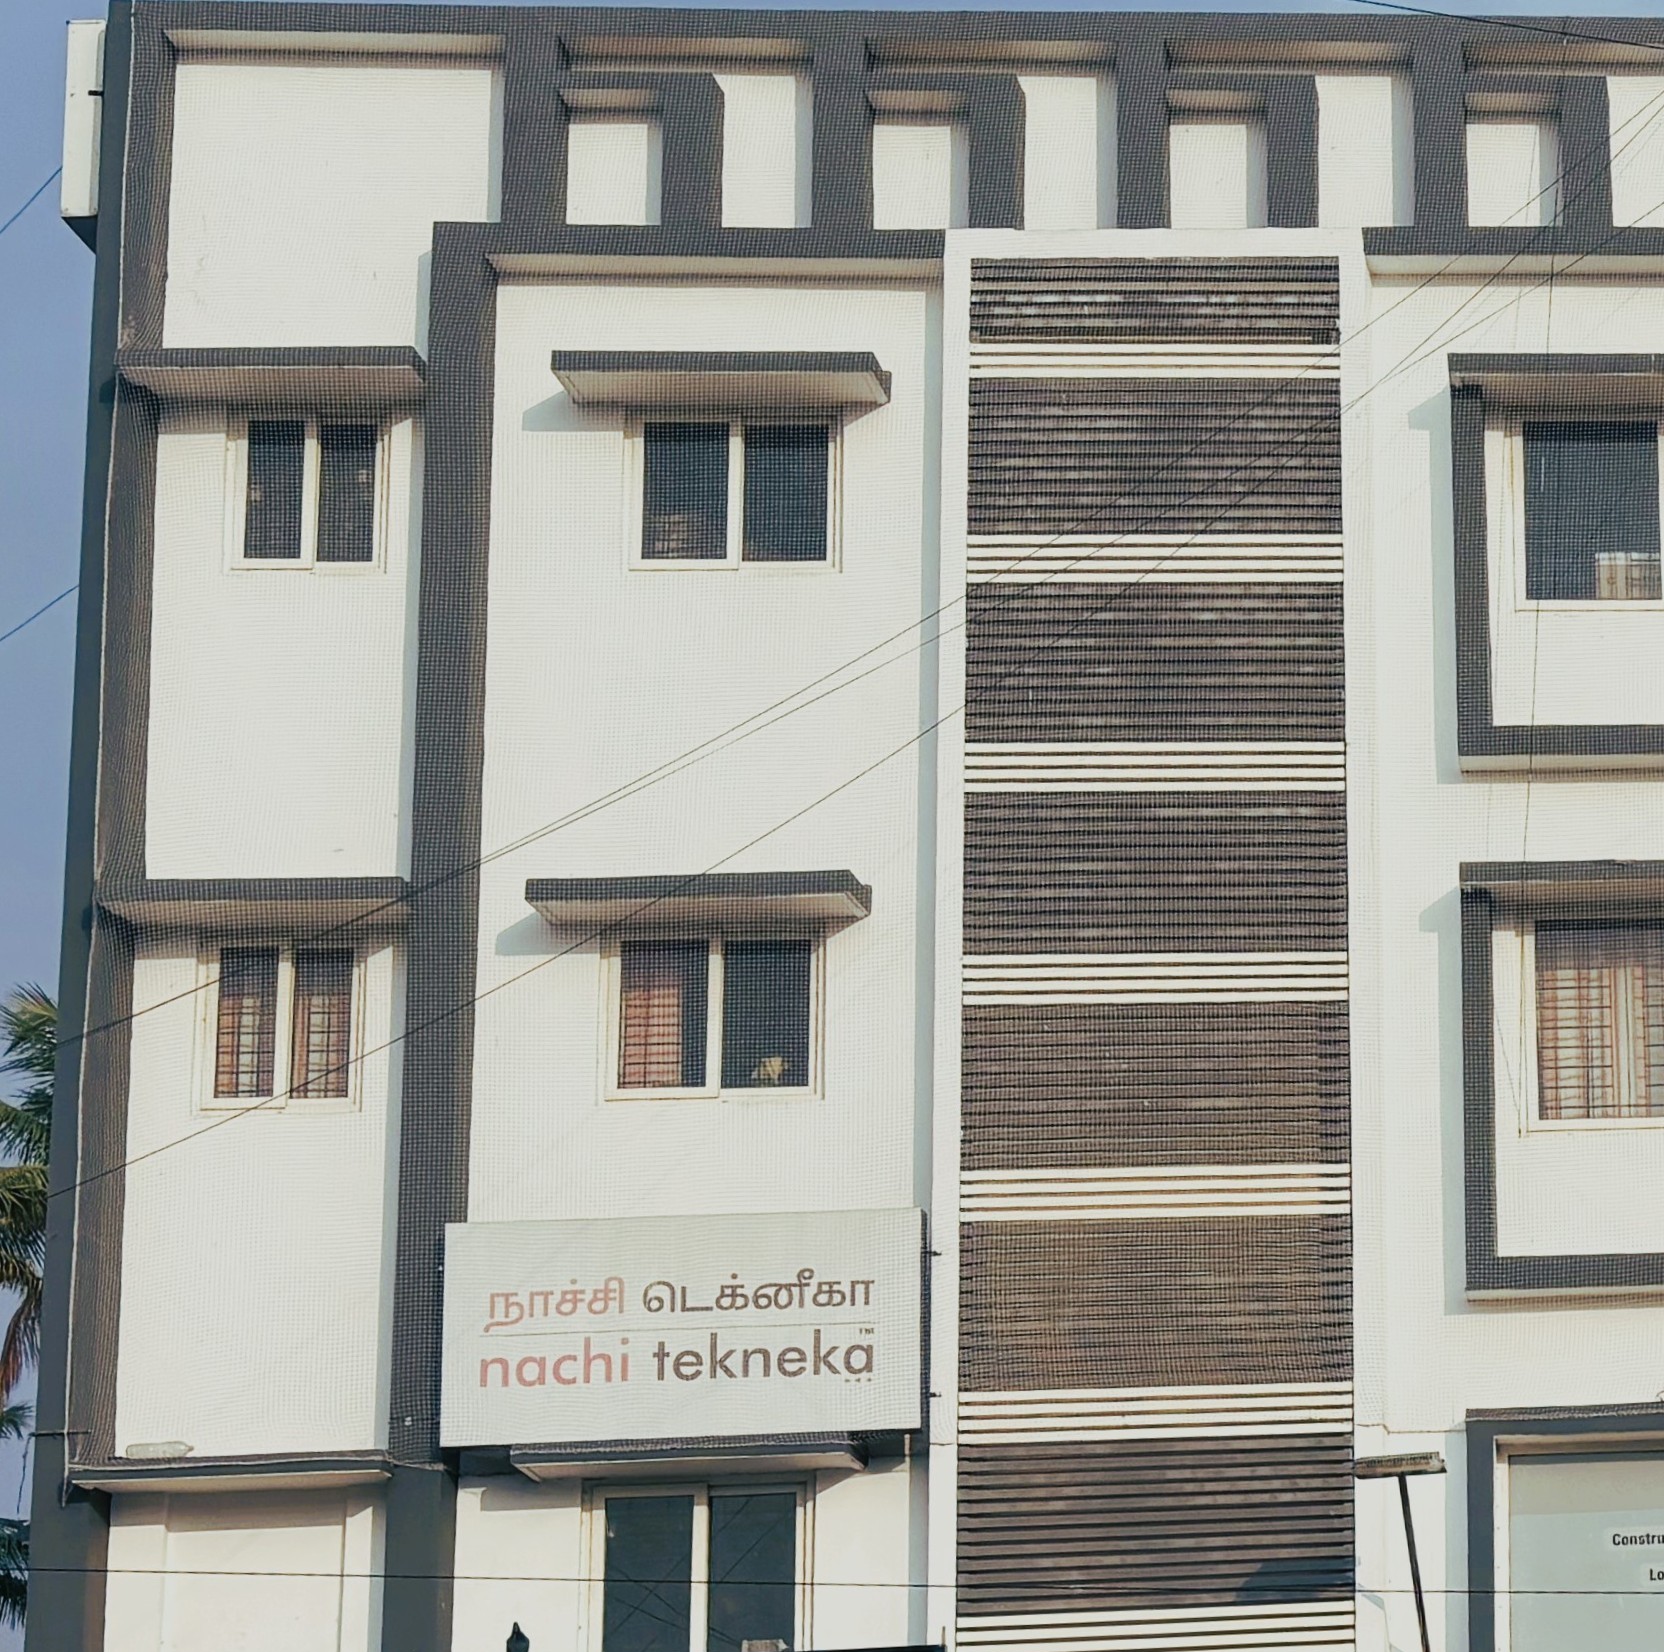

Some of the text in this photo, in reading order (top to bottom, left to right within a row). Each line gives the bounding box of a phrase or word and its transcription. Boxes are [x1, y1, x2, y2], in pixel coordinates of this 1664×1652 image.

[484, 1267, 875, 1333] நாச்சி டெக்னீகா
[479, 1328, 874, 1388] nachi tekneka
